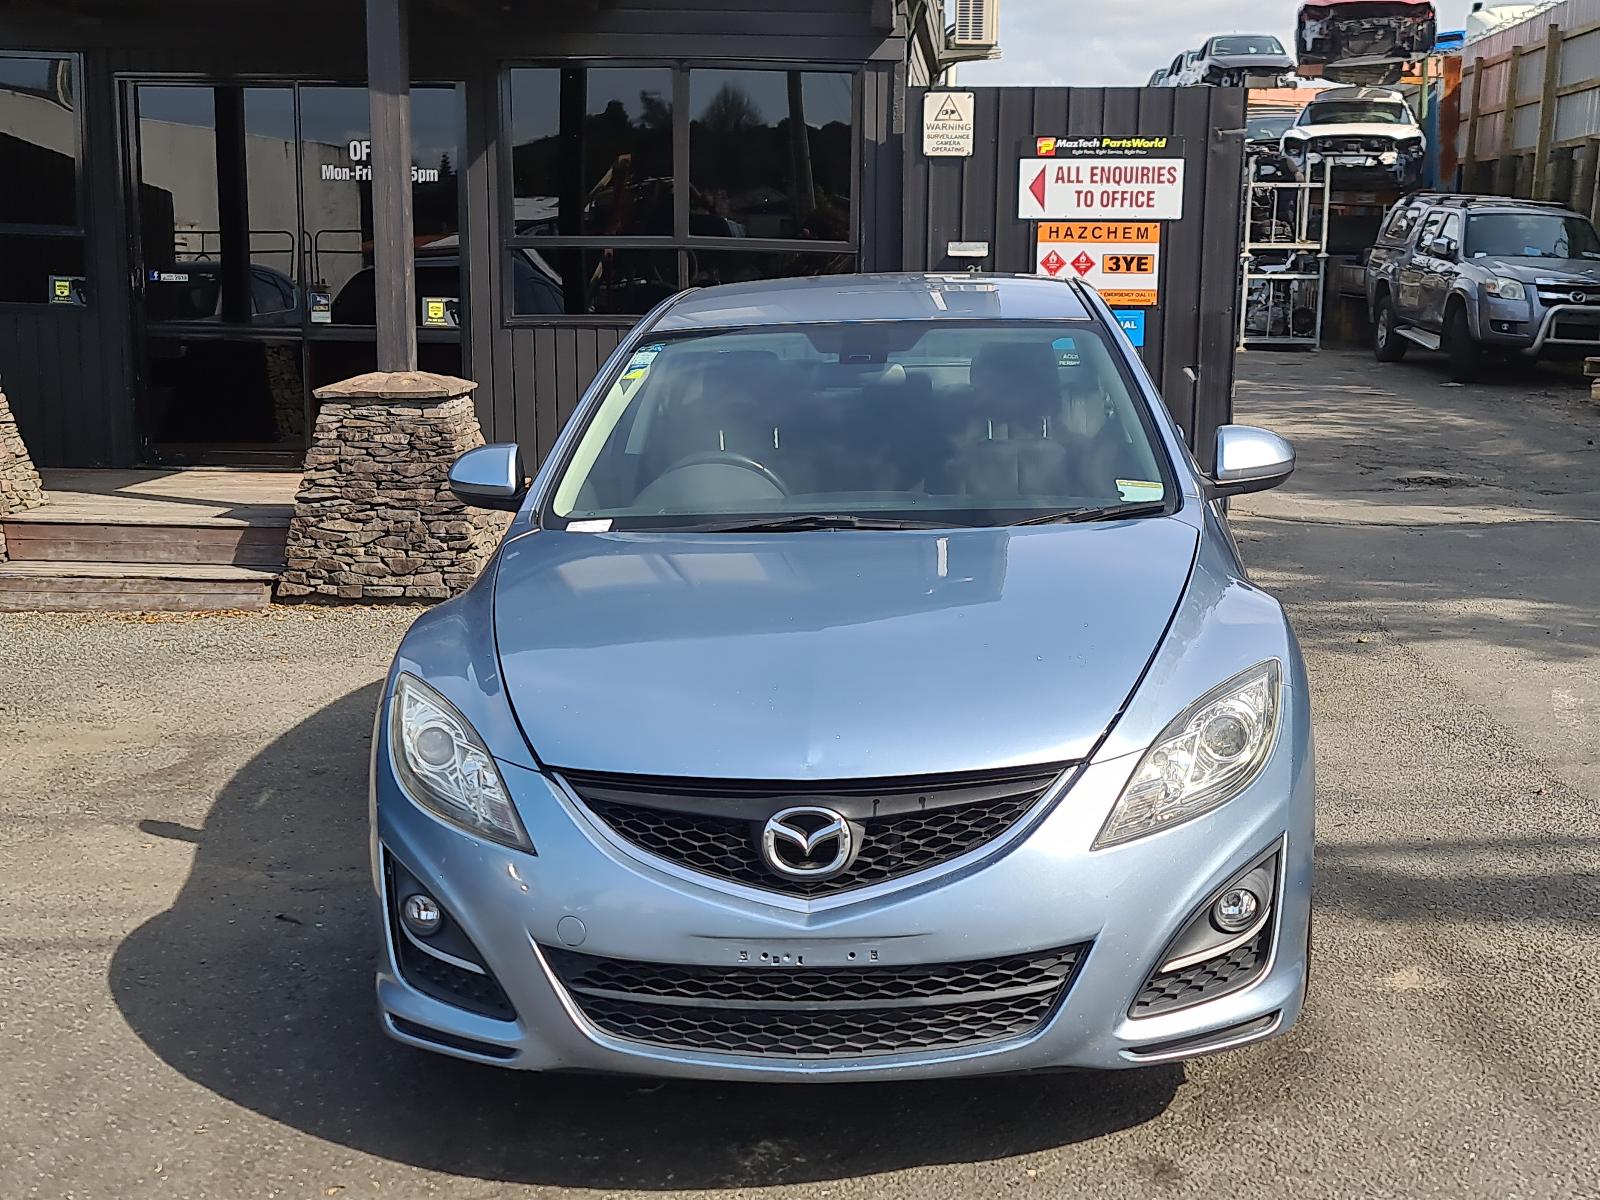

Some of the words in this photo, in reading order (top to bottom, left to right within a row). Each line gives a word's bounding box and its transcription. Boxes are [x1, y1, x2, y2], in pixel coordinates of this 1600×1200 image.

[926, 123, 971, 131] WARNING
[1056, 138, 1100, 148] MazTech
[1102, 138, 1167, 148] PartsWorld
[321, 164, 371, 181] Mon-Fri
[1055, 166, 1083, 184] ALL
[1090, 166, 1177, 186] ENQUIRIES
[1075, 190, 1094, 208] TO
[1100, 190, 1155, 208] OFFICE
[1048, 226, 1149, 240] HAZCHEM
[1108, 256, 1149, 272] 3YE
